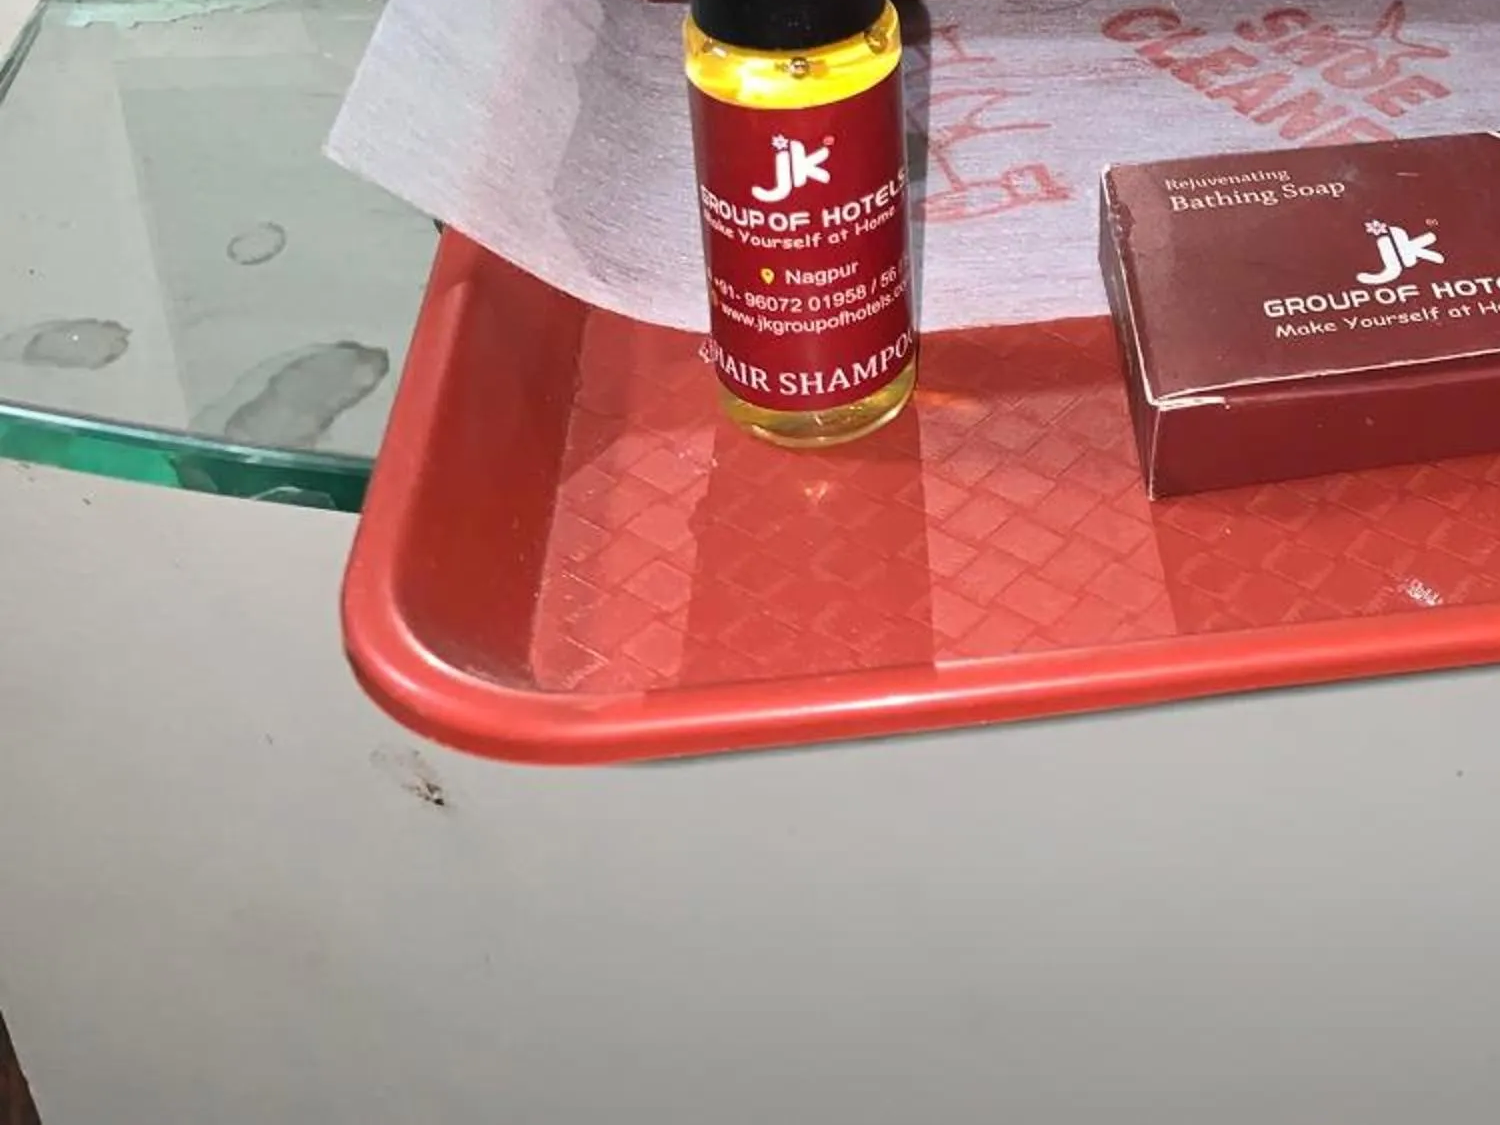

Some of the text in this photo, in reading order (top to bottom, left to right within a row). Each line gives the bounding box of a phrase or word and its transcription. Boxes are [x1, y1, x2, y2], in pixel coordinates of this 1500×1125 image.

[1164, 170, 1291, 191] Rejuvenating
[1169, 181, 1346, 213] Bathing Soap
[767, 211, 811, 232] OF
[738, 228, 821, 249] Yourself
[828, 228, 848, 244] at
[785, 262, 860, 286] Nagpur
[745, 291, 803, 312] 96072
[808, 284, 867, 312] 01958
[1263, 289, 1370, 318] GROUP
[1374, 284, 1421, 306] OF
[1275, 321, 1337, 339] Make
[1345, 306, 1440, 330] Yourself
[1448, 304, 1471, 319] at
